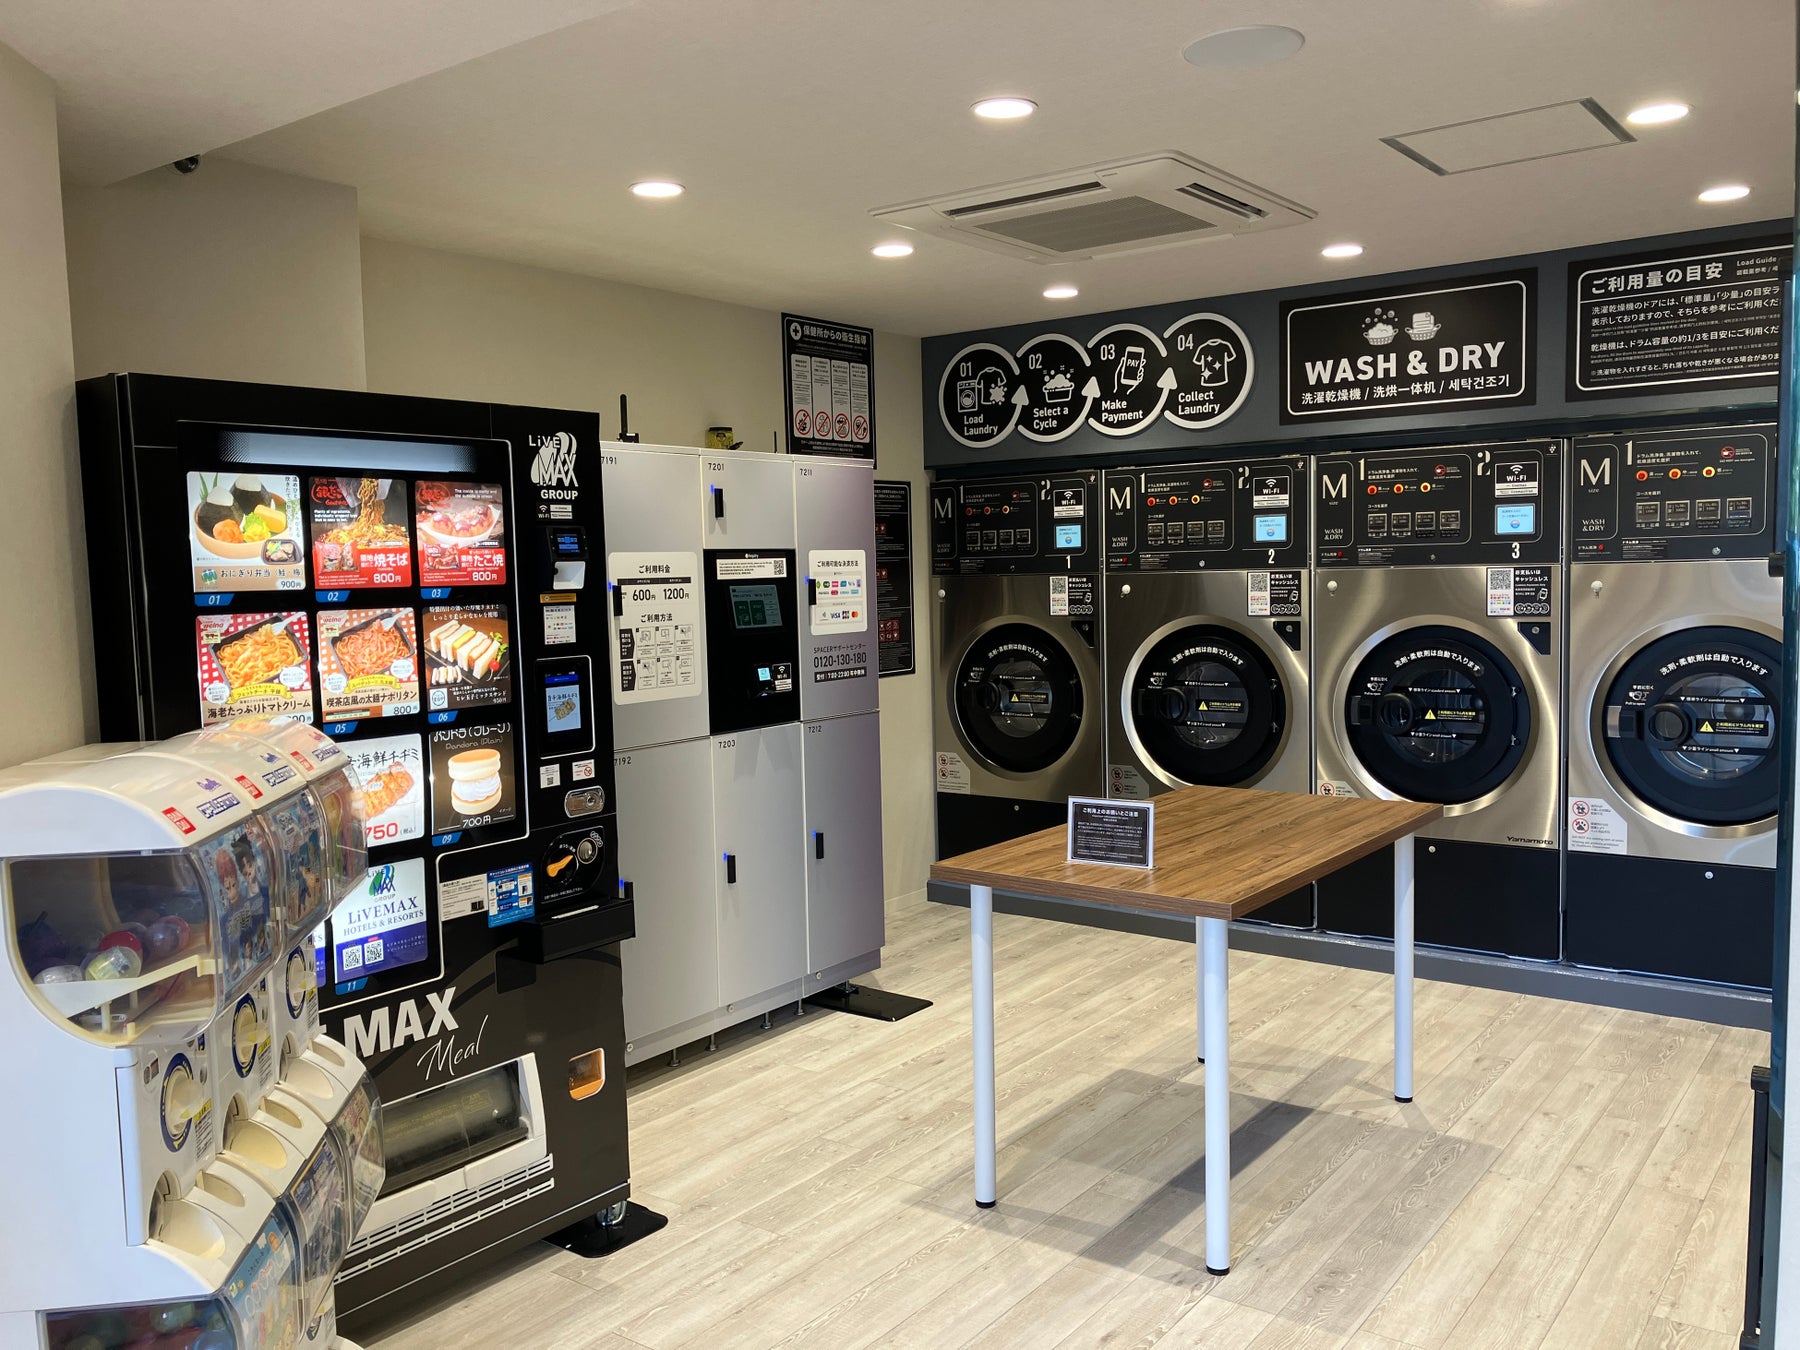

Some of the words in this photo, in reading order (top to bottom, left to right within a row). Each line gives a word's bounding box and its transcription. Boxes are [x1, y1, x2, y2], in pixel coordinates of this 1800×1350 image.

[1736, 259, 1754, 267] Load
[1756, 256, 1777, 264] Guide
[1592, 262, 1723, 294] ご利用量の目安
[1592, 298, 1781, 326] 表示しておりますので、そちらを参考にご利用くだ
[1178, 334, 1194, 351] 04
[1100, 344, 1116, 360] 03
[1028, 354, 1042, 370] 02
[1126, 359, 1140, 368] PAY
[1305, 353, 1398, 386] WASH
[1406, 350, 1429, 376] &
[1438, 341, 1506, 373] DRY
[960, 362, 972, 377] 01
[1302, 386, 1362, 404] 洗濯乾燥機
[1373, 381, 1436, 398] 洗烘一体机
[1448, 374, 1510, 392] 세탁건조기
[1178, 390, 1214, 404] Collect
[1033, 406, 1060, 419] Select
[1062, 408, 1069, 416] a
[1102, 400, 1127, 411] Make
[1178, 402, 1220, 415] Laundry
[964, 413, 984, 425] Load
[1102, 410, 1144, 423] Payment
[964, 424, 998, 436] Laundry
[1033, 418, 1058, 430] Cycle
[528, 434, 560, 448] LiVE
[1624, 440, 1633, 466] 1
[600, 456, 618, 465] 7191
[708, 463, 725, 471] 7201
[538, 452, 579, 487] MAX
[800, 468, 813, 477] 7211
[1358, 458, 1365, 480] 1
[1580, 458, 1610, 486] M
[1140, 472, 1146, 494] 1
[1506, 474, 1527, 482] Wi-Fi
[1322, 473, 1347, 500] M
[540, 490, 578, 500] GROUP
[959, 485, 964, 504] 1
[1110, 486, 1131, 510] M
[934, 498, 952, 520] M
[1268, 548, 1276, 564] 2
[1511, 542, 1520, 559] 3
[374, 552, 408, 567] 焼そば
[473, 554, 504, 566] たこ焼
[1066, 555, 1071, 569] 1
[639, 564, 671, 574] ご利用料金
[373, 573, 401, 583] 800円
[472, 572, 497, 581] 800円
[208, 595, 221, 605] 01
[328, 592, 339, 601] 02
[431, 589, 441, 598] 03
[632, 588, 656, 602] 600円
[663, 588, 690, 600] 1200円
[640, 613, 673, 623] ご利用方法
[814, 652, 867, 668] 0120-130-180
[1170, 646, 1244, 666] 洗剤・柔軟剤は自動で入ります
[1394, 649, 1480, 672] 洗剤・柔軟剤は自動で入ります
[1659, 653, 1769, 676] 洗剤・柔軟剤は自動で入ります
[326, 691, 417, 708] 喫茶店風の太麺ナポリタン
[207, 699, 311, 718] 海老たっぷりトマトクリーム
[394, 705, 418, 715] 800円
[438, 713, 448, 722] 06
[335, 724, 346, 733] 05
[808, 725, 822, 734] 7212
[718, 739, 736, 749] 7203
[614, 756, 632, 766] 7192
[462, 814, 491, 828] 700円
[366, 822, 398, 840] 750
[442, 835, 452, 844] 09
[1506, 836, 1554, 846] Yamamoto
[367, 868, 385, 878] LiVE
[374, 878, 396, 896] MAX
[348, 896, 418, 924] LiVEMAX
[344, 922, 378, 937] HOTELS
[380, 920, 385, 928] &
[388, 910, 424, 925] RESORTS
[347, 981, 357, 991] 11
[344, 986, 459, 1058] MAX
[416, 1014, 488, 1080] Meal
